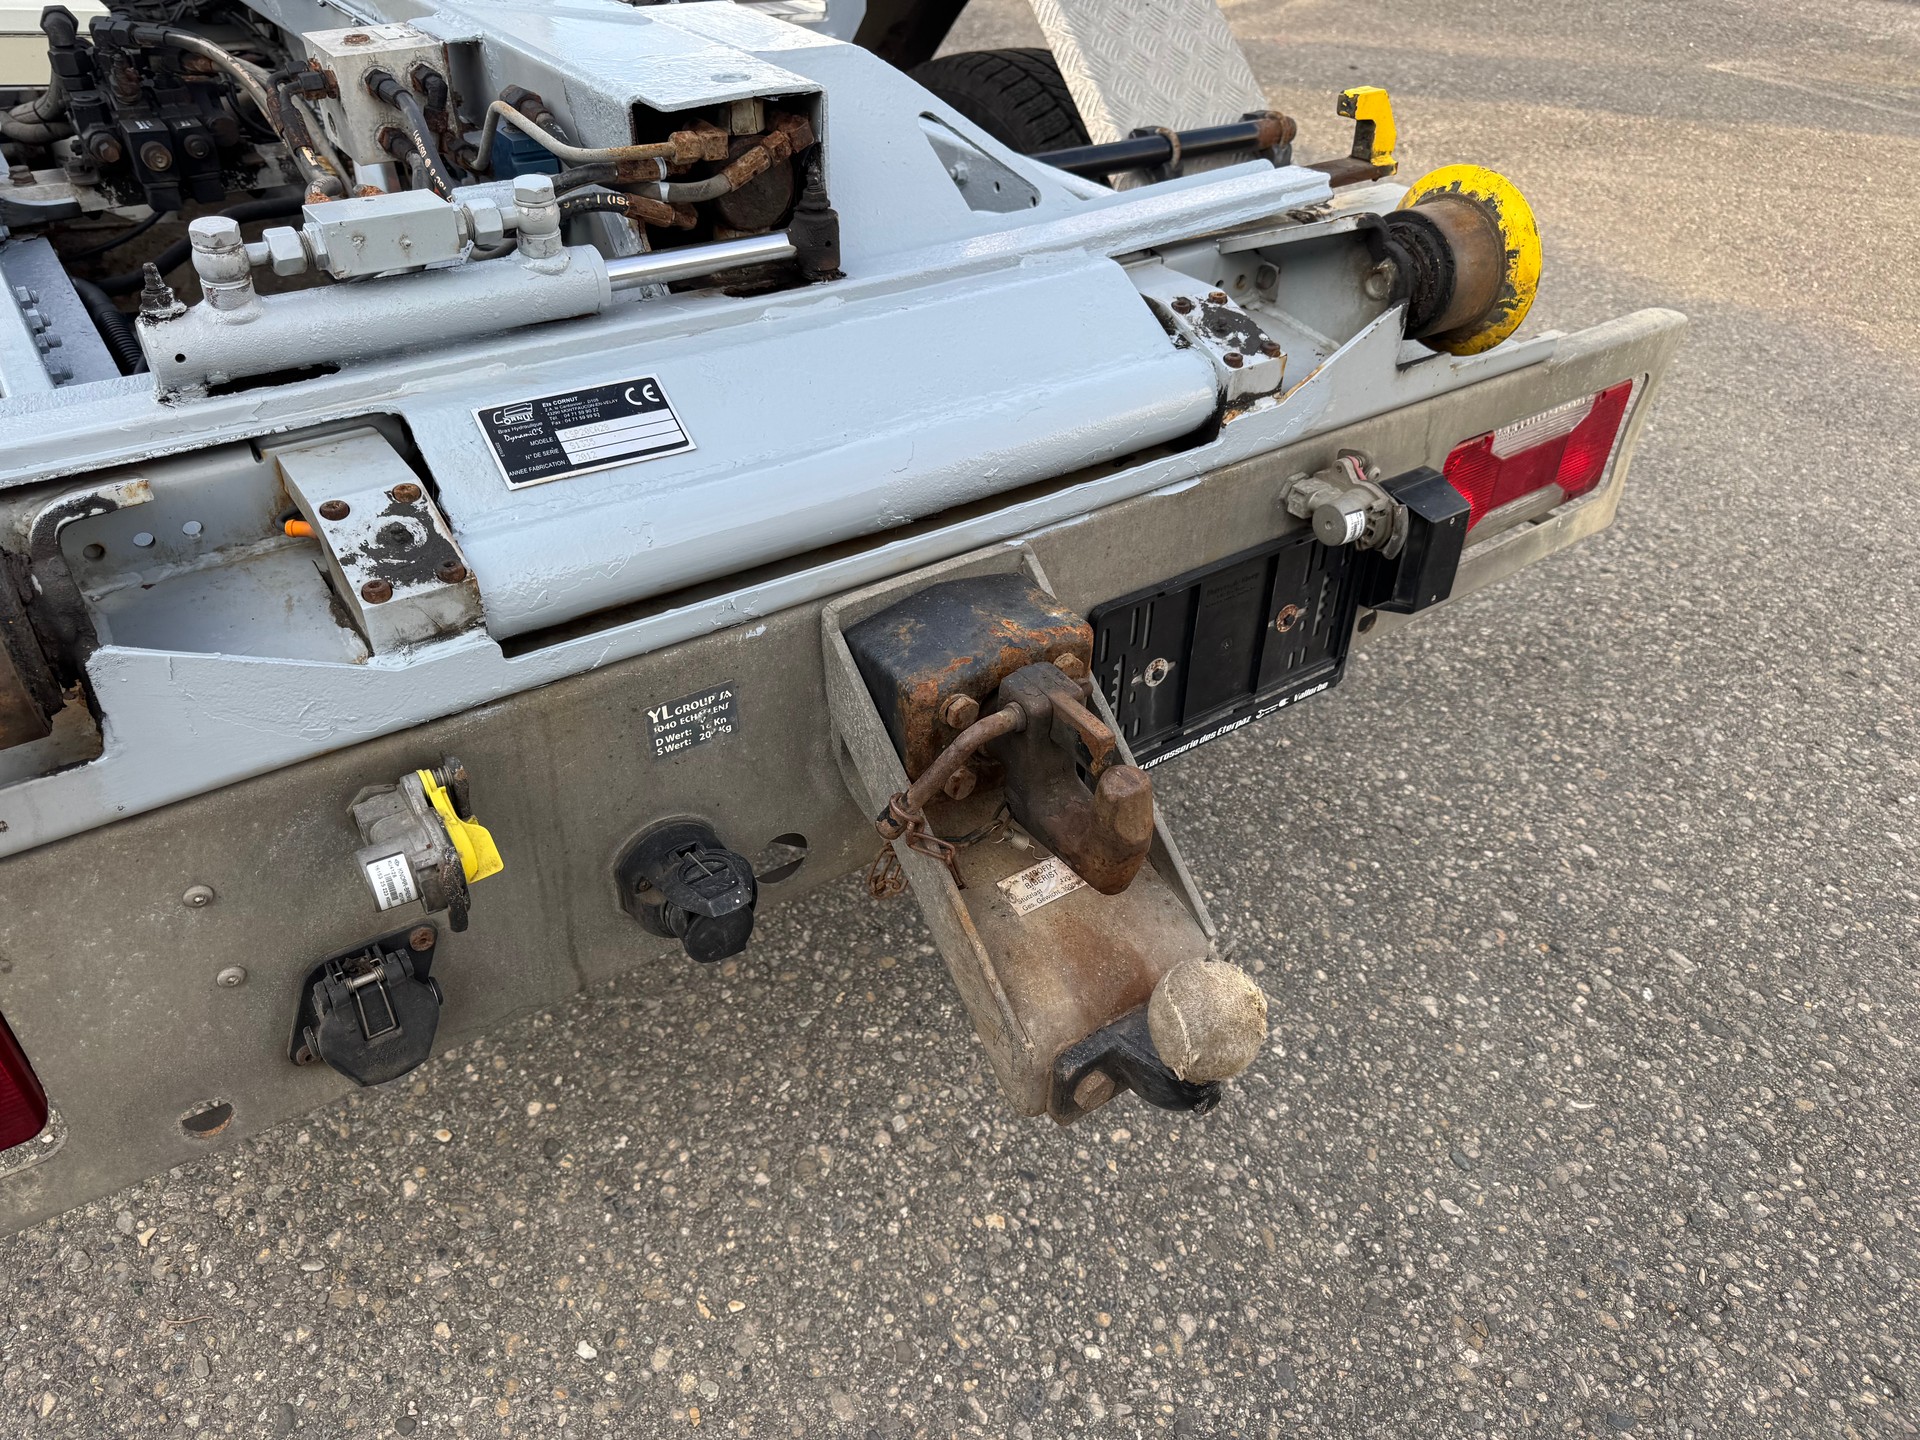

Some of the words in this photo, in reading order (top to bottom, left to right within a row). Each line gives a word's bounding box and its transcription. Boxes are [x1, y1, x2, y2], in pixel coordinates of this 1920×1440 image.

[552, 396, 578, 406] CORNUT
[624, 383, 660, 406] CE
[511, 421, 543, 432] Hydraulique
[533, 451, 541, 459] DE
[509, 467, 528, 477] ANNEE
[528, 460, 566, 473] FABRICATION
[647, 704, 674, 724] YL
[674, 695, 715, 716] GROUP
[719, 690, 732, 701] SA
[655, 738, 664, 747] D
[665, 729, 692, 743] Wert:
[713, 717, 727, 726] Kn
[1144, 739, 1199, 770] carrosserie
[1199, 730, 1217, 744] des
[1217, 715, 1252, 737] Eterpaz
[1293, 681, 1329, 702] Vallorbe
[656, 747, 664, 756] S
[664, 738, 692, 753] Wert:
[718, 724, 732, 734] Kg
[1024, 869, 1059, 890] BIBERIST
